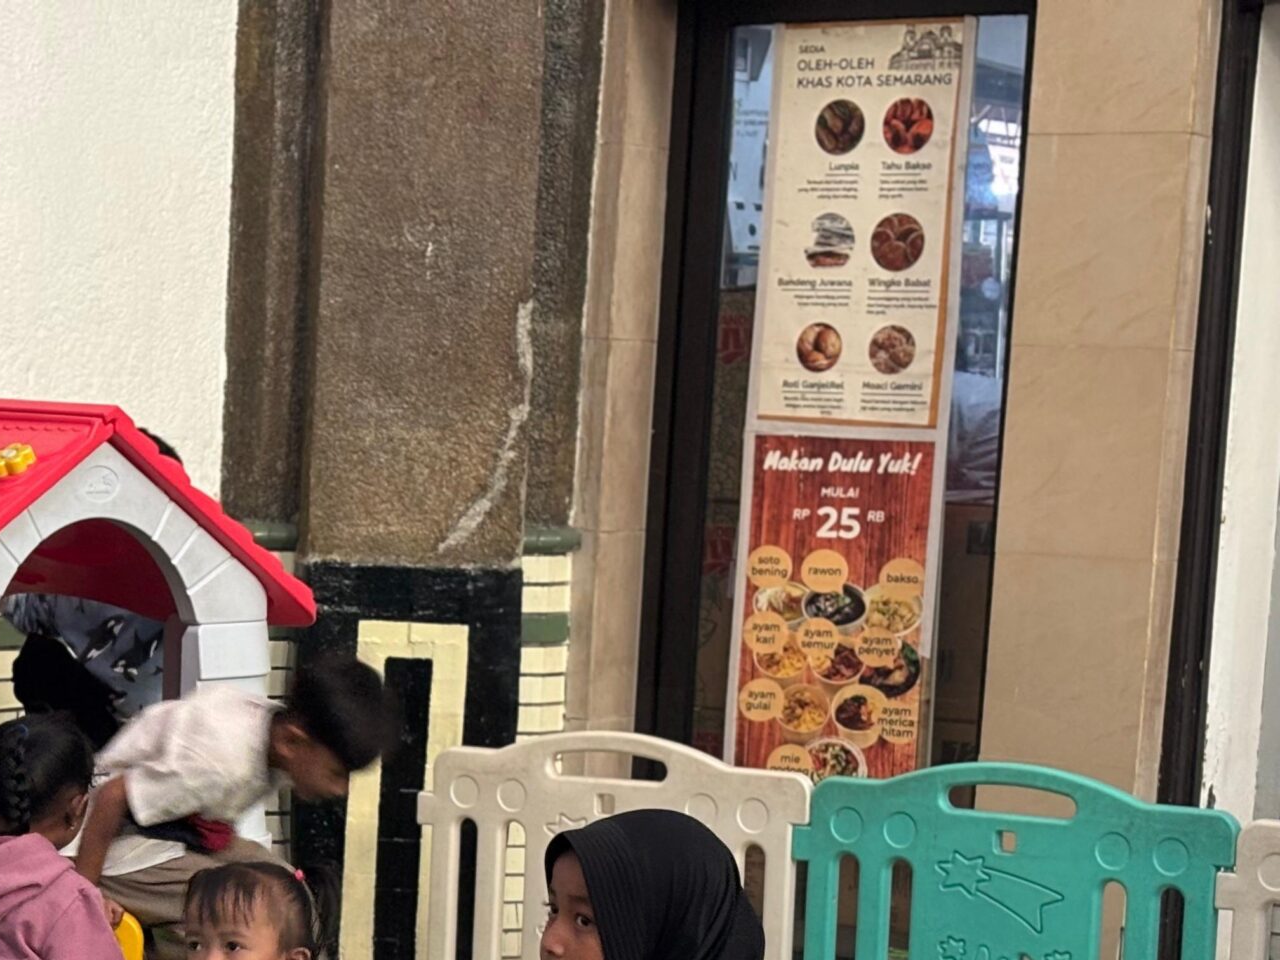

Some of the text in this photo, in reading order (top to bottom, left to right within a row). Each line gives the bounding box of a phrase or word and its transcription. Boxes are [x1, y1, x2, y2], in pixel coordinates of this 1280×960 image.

[798, 44, 826, 54] SEDIA
[797, 57, 875, 72] OLEH-OLEH
[797, 73, 953, 89] KHAS KOTA SEMARANG
[880, 160, 932, 171] Tahu Bakso
[777, 277, 817, 290] Bandeng
[868, 277, 902, 290] Wingko
[763, 451, 923, 476] Makan Dulu Yuk!
[820, 486, 860, 499] MULAI
[792, 506, 885, 540] RP 25 RB
[757, 555, 781, 566] soto
[751, 565, 789, 580] bening
[808, 566, 842, 578] rawon
[886, 572, 919, 584] bakso
[751, 623, 781, 635] ayam
[803, 629, 833, 641] ayam
[755, 633, 776, 645] kari
[801, 639, 836, 650] semur
[862, 636, 892, 648] ayam
[858, 644, 896, 658] penyet
[746, 691, 776, 703] ayam
[745, 699, 771, 712] gulai
[881, 706, 911, 719] ayam
[877, 716, 915, 727] merica
[880, 726, 914, 739] hitam
[780, 753, 801, 765] mie
